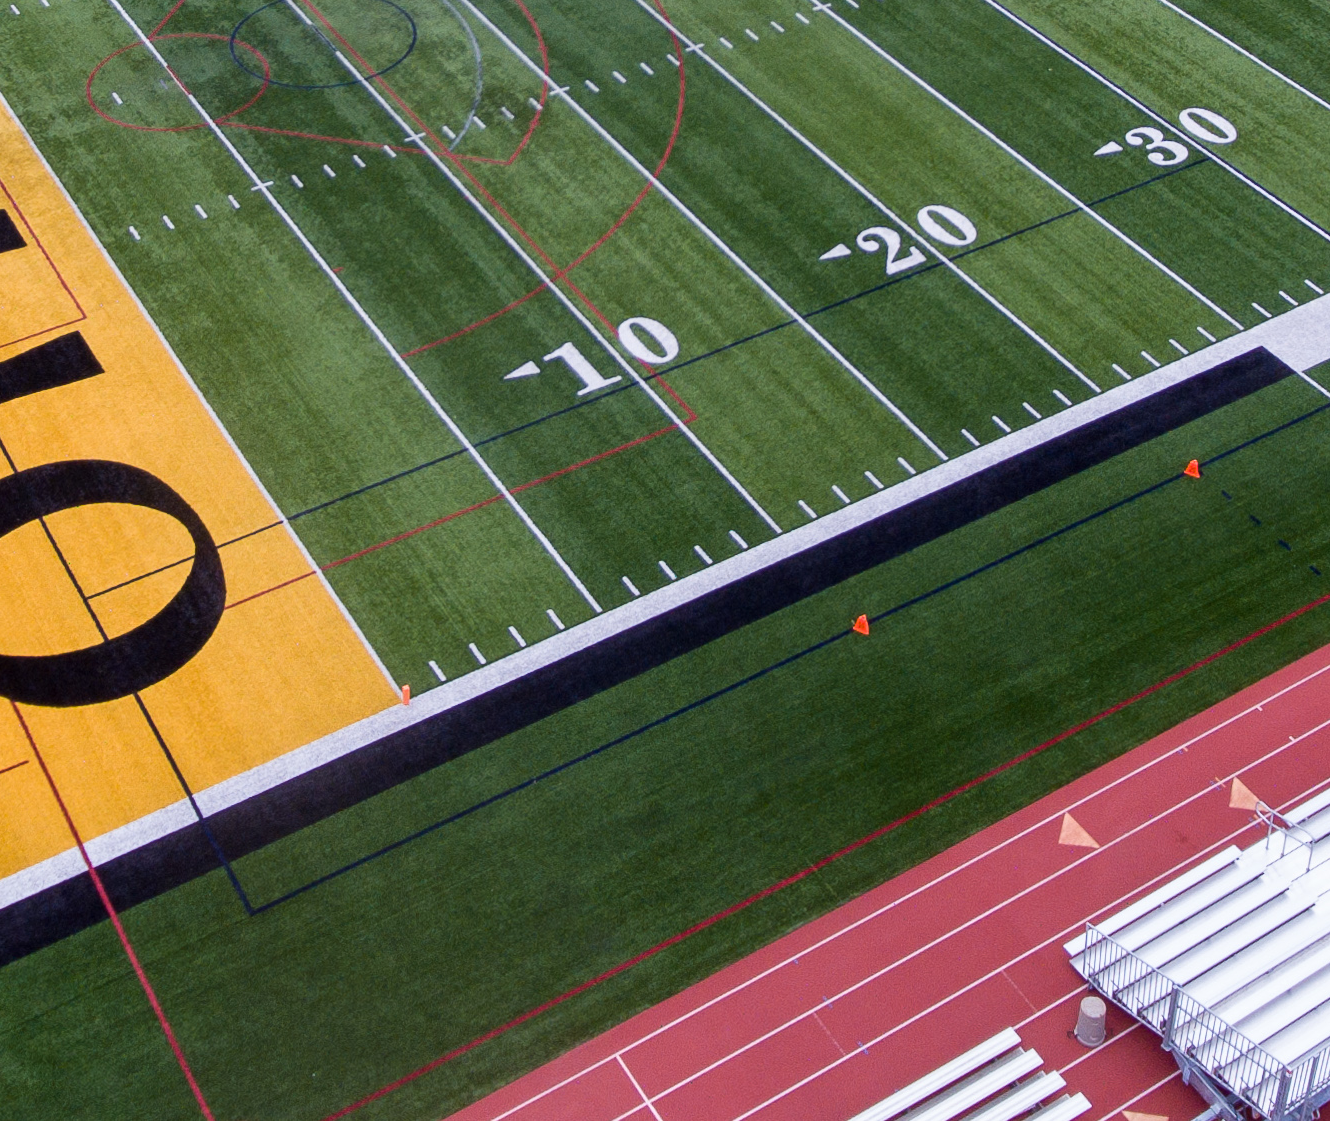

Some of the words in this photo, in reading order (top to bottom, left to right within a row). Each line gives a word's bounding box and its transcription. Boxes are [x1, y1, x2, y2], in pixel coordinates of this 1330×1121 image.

[1125, 107, 1238, 166] 30
[856, 204, 977, 275] 20
[543, 316, 679, 395] 10
